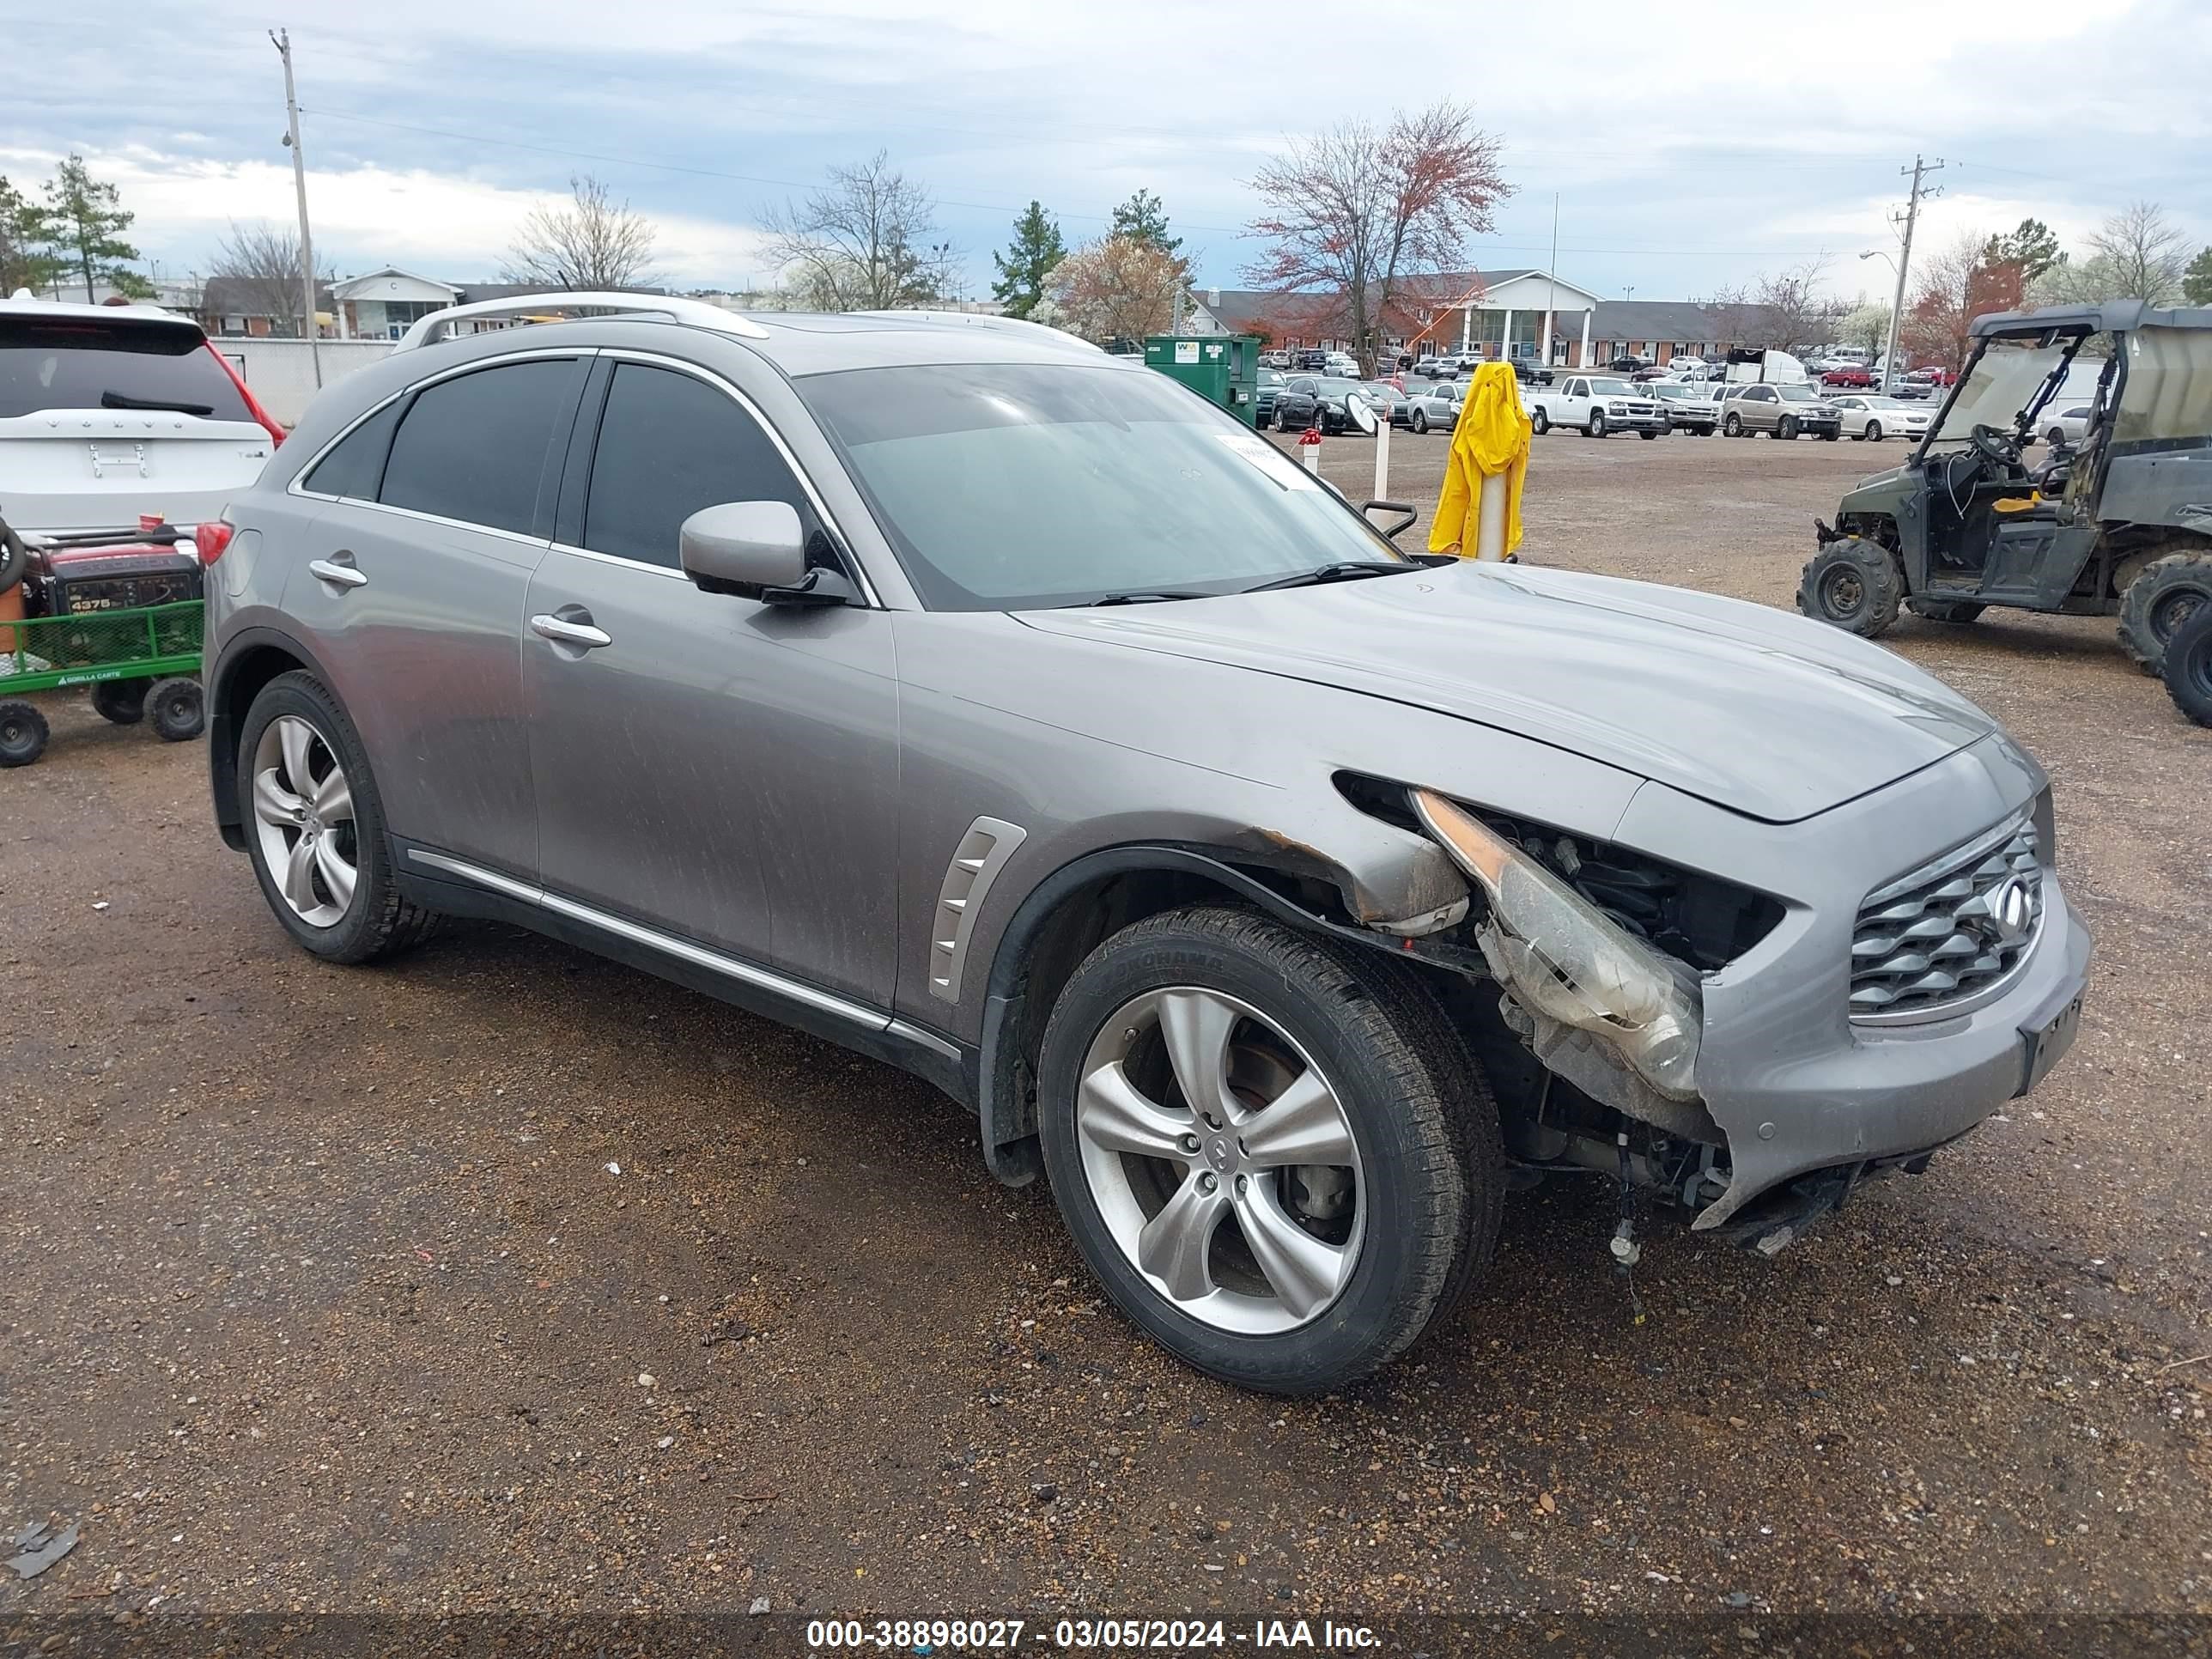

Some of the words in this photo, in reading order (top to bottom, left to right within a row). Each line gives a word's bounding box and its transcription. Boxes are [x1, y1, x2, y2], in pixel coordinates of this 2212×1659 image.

[391, 282, 398, 290] C
[71, 599, 111, 610] 4375
[67, 674, 96, 684] GORILLA
